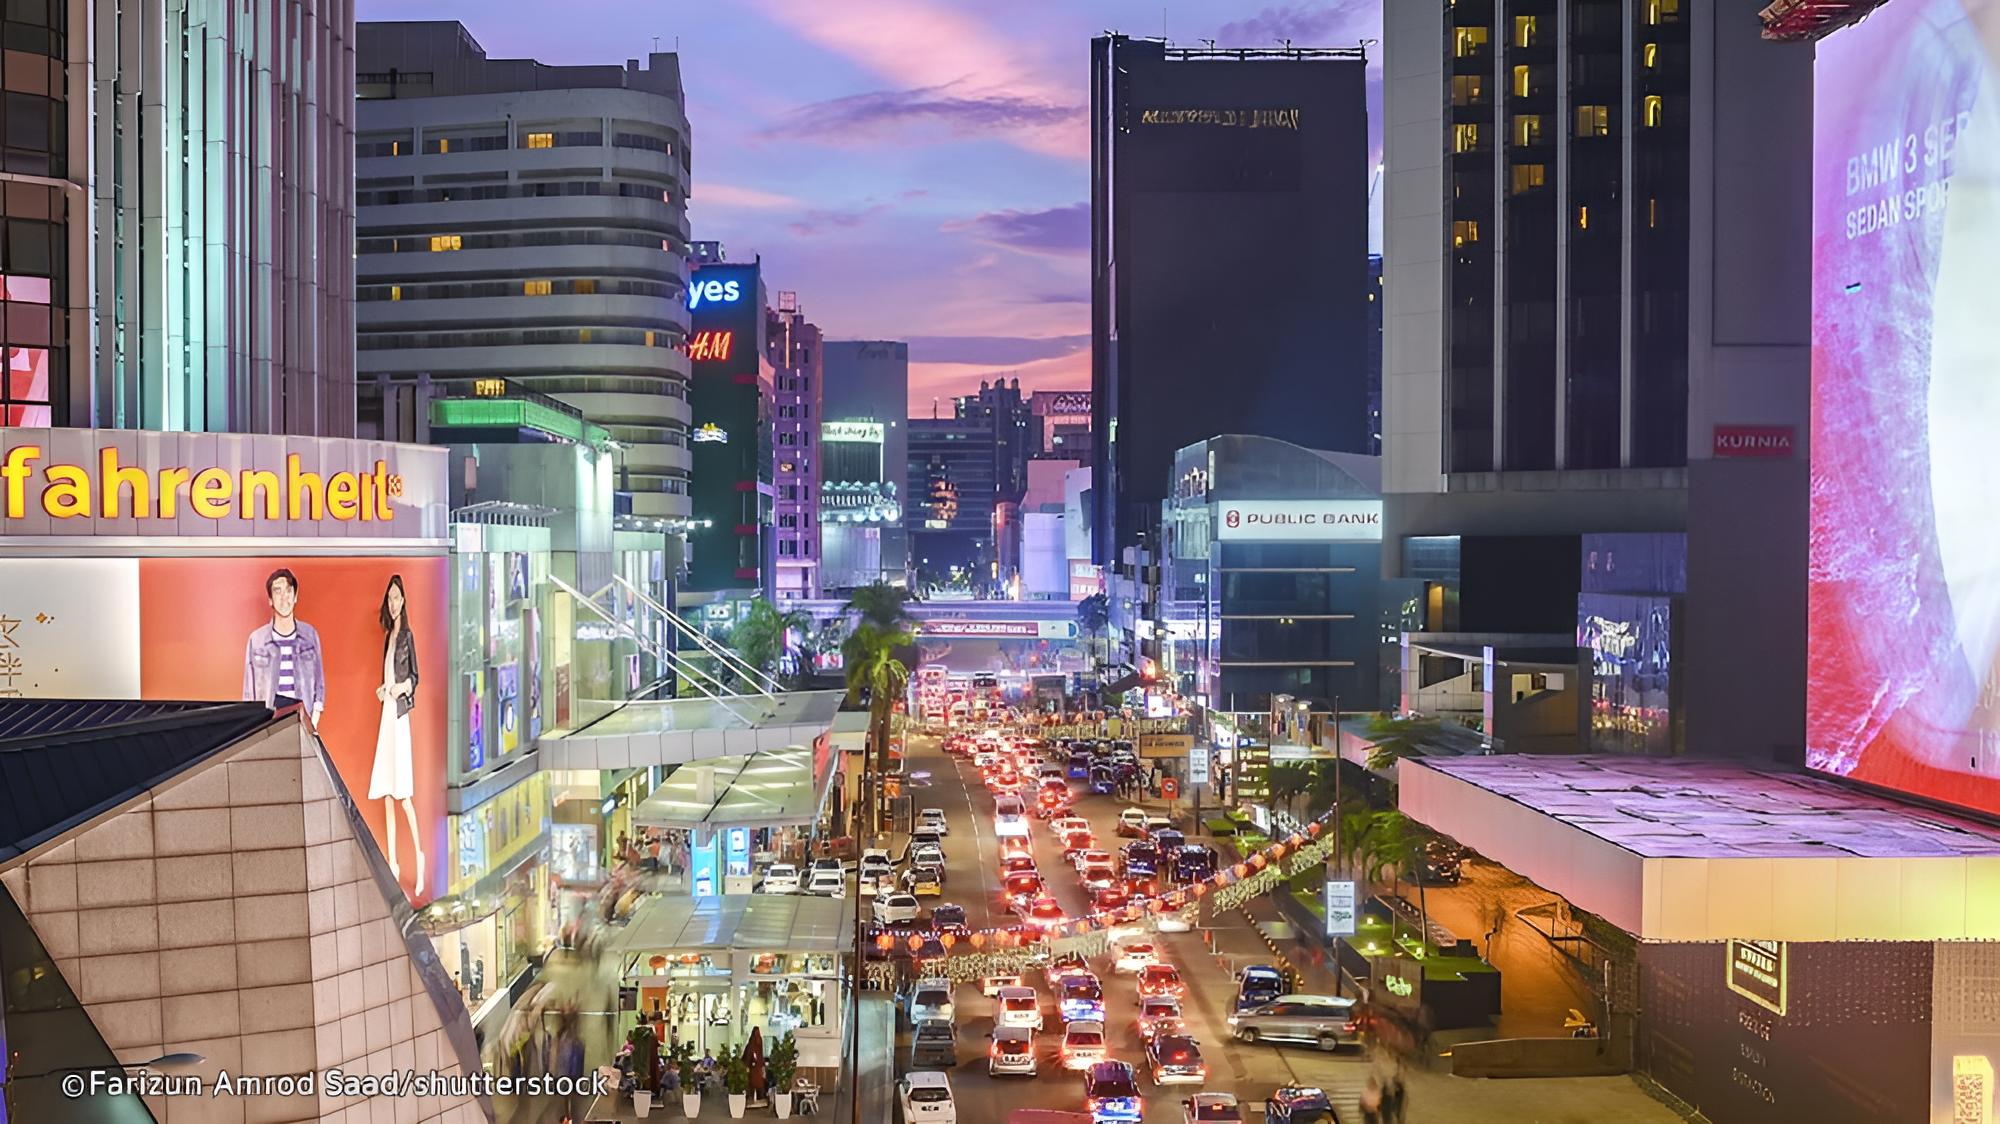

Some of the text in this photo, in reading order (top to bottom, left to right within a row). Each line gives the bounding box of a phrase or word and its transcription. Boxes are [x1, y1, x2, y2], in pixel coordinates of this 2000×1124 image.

[1846, 138, 1900, 197] BMW
[1904, 133, 1917, 174] 3
[1846, 194, 1900, 240] SEDAN
[689, 280, 740, 309] yes
[1717, 435, 1789, 448] KURNIA
[1247, 513, 1378, 525] PUBLIC BANK
